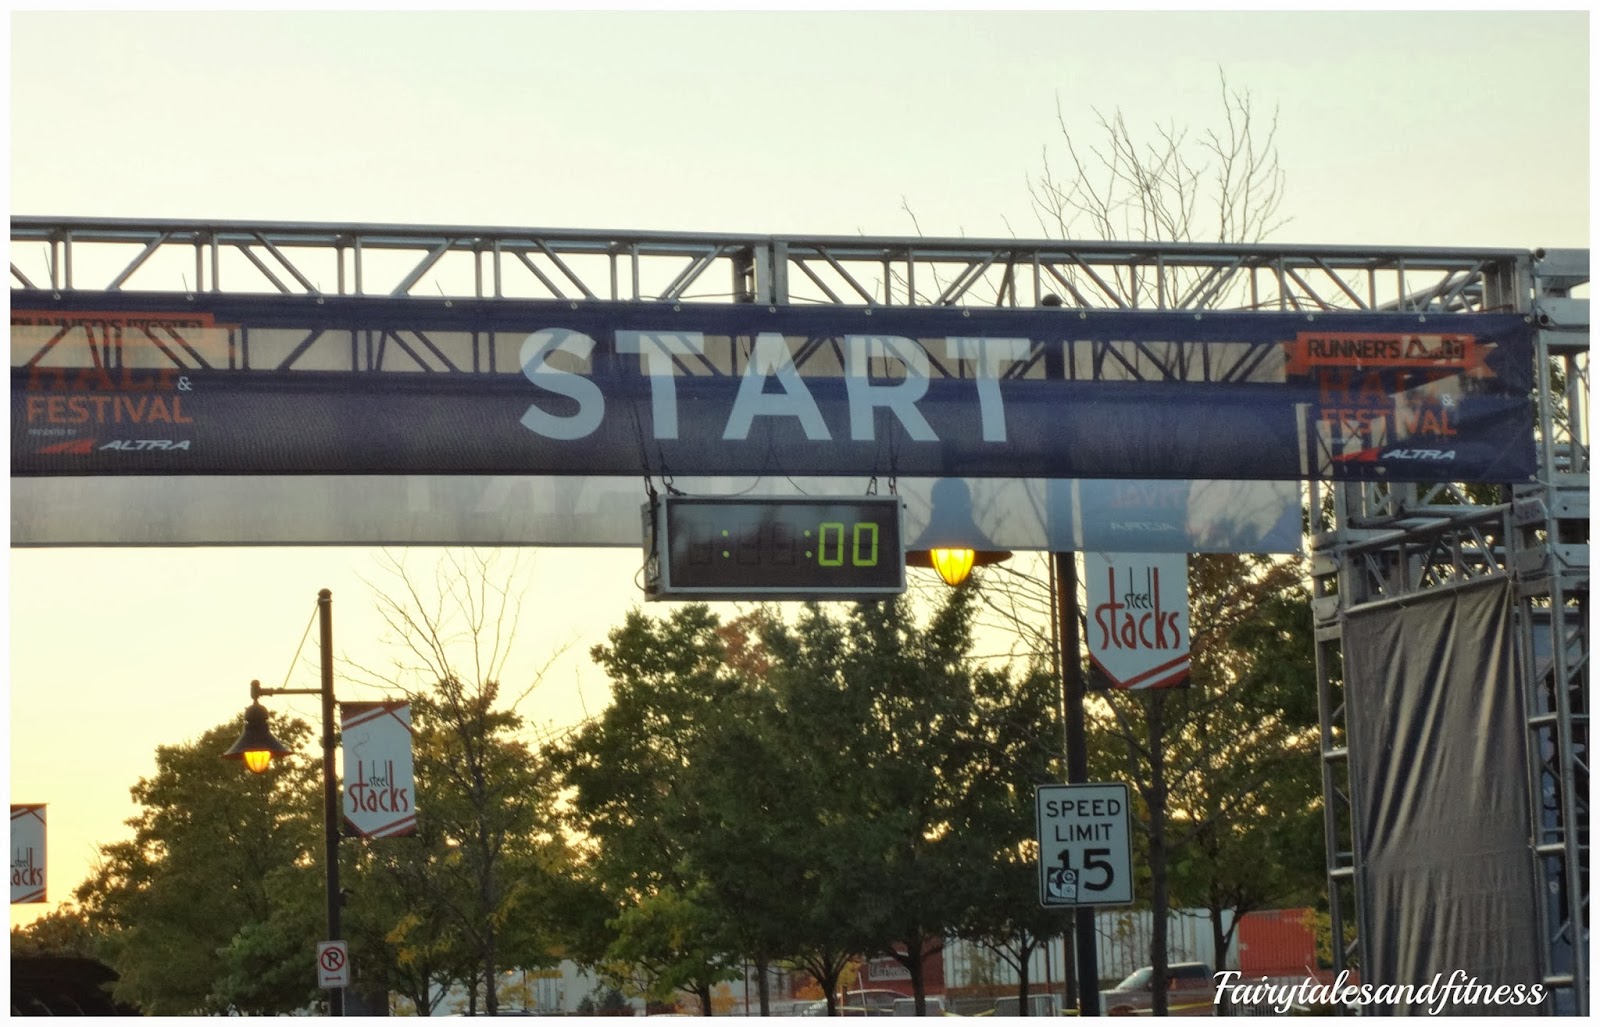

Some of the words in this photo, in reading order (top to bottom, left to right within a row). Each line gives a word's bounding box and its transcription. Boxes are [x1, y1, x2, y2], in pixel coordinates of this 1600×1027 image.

[1307, 338, 1400, 359] RUNNER'S
[177, 376, 193, 391] &
[517, 326, 1032, 442] START
[26, 395, 193, 424] FESTIVAL
[100, 439, 191, 451] ALTRA
[1382, 449, 1457, 460] ALTRA
[1123, 566, 1154, 610] steel
[1094, 566, 1181, 650] stacks
[348, 760, 408, 813] stacks
[369, 760, 389, 788] steel
[1046, 799, 1121, 818] SPEED
[1055, 823, 1113, 842] LIMIT
[10, 847, 43, 886] acks
